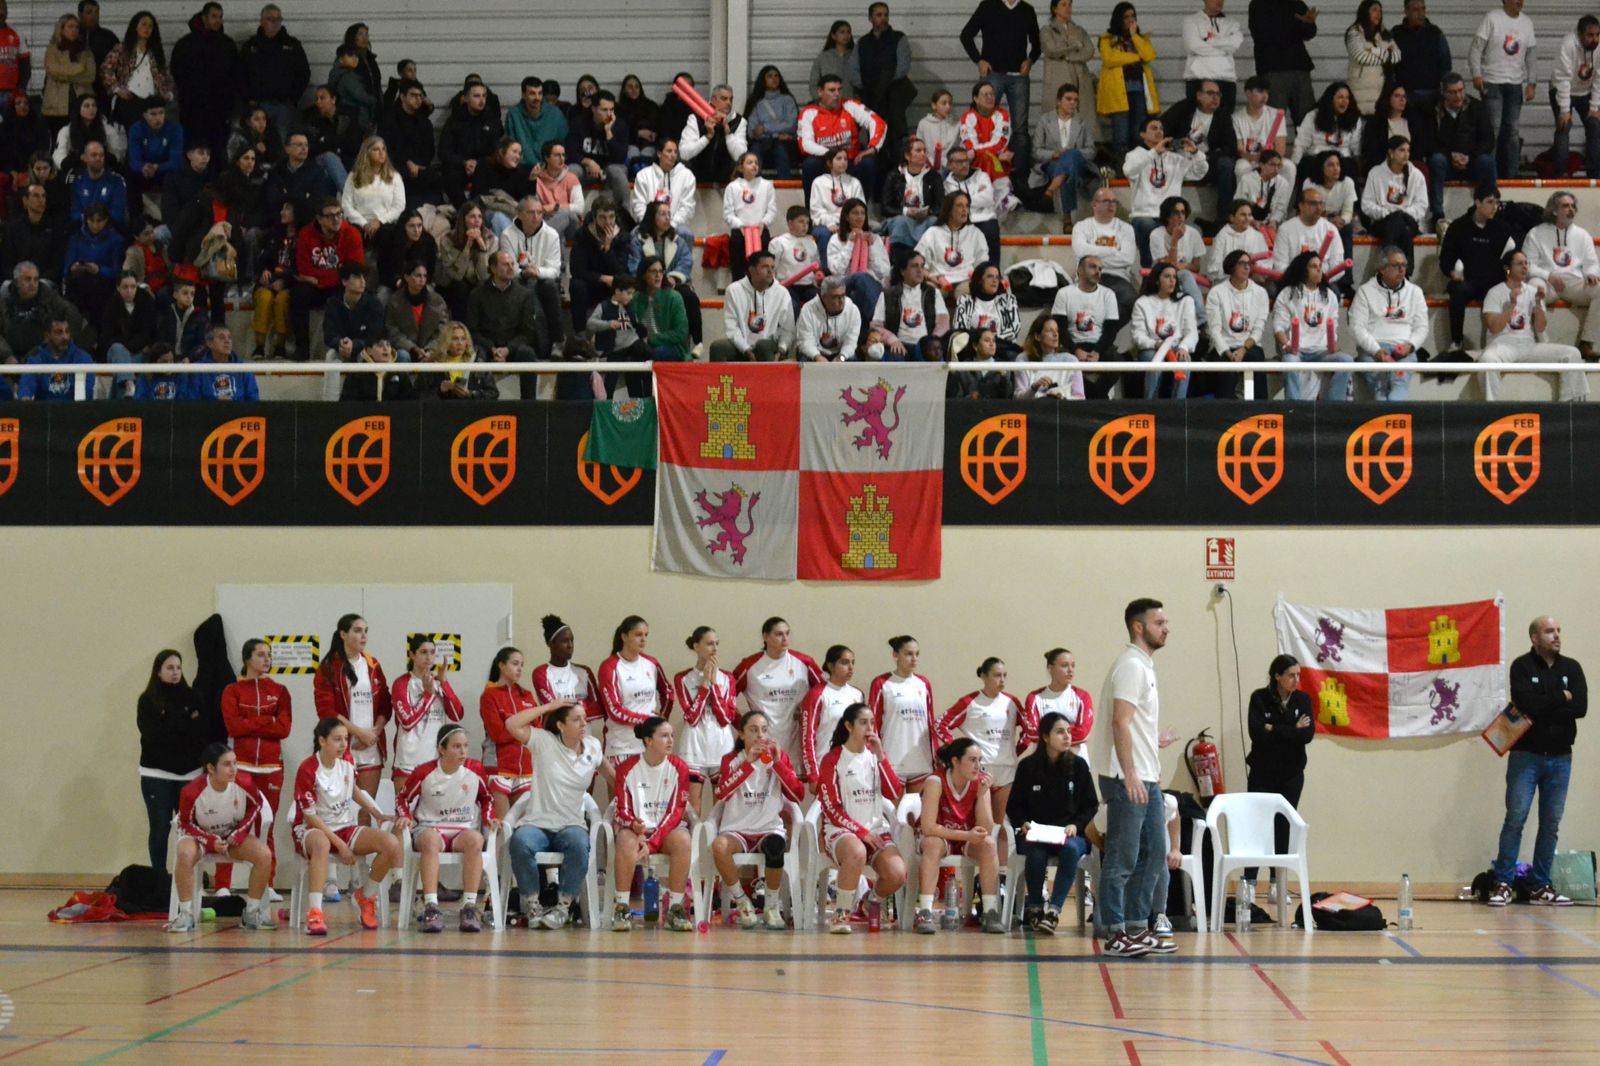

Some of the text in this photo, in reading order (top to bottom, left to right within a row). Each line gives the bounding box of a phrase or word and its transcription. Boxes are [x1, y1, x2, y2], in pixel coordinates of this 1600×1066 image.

[0, 423, 14, 432] EB
[116, 422, 137, 432] FEB
[240, 421, 261, 431] FEB
[364, 421, 385, 431] FEB
[490, 420, 511, 430] FEB
[1000, 419, 1021, 428] FEB
[1128, 419, 1150, 428] FEB
[1257, 419, 1278, 429] FEB
[1385, 419, 1406, 429] FEB
[1513, 419, 1535, 428] FEB
